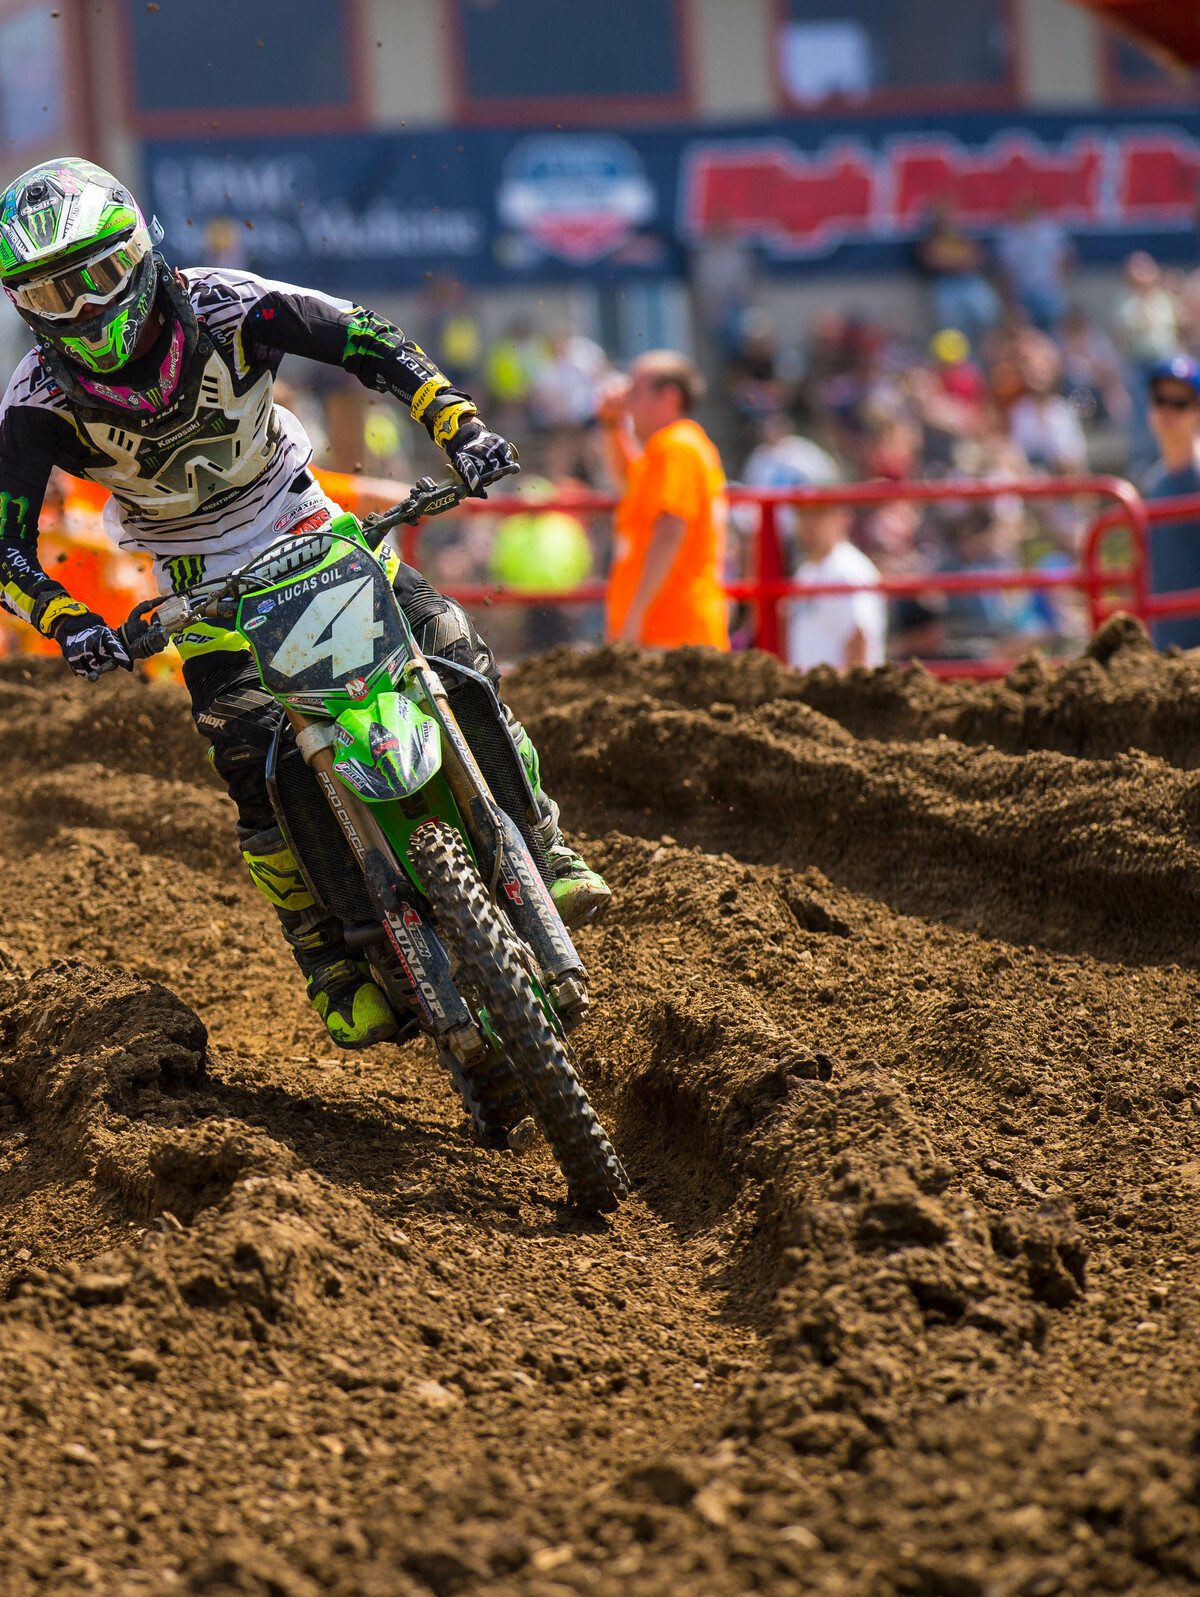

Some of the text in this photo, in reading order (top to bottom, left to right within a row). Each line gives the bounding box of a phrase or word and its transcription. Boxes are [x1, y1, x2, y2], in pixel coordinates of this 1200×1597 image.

[157, 420, 200, 447] Kawasaki
[201, 489, 240, 510] SENTINEL
[424, 493, 456, 512] ARC
[277, 577, 319, 605] LUCAS
[321, 568, 342, 585] OIL
[269, 575, 384, 679] 4
[197, 712, 227, 730] THOR
[318, 771, 343, 808] PRO
[508, 851, 572, 959] DUNLOP
[384, 909, 446, 1018] DUNLOP
